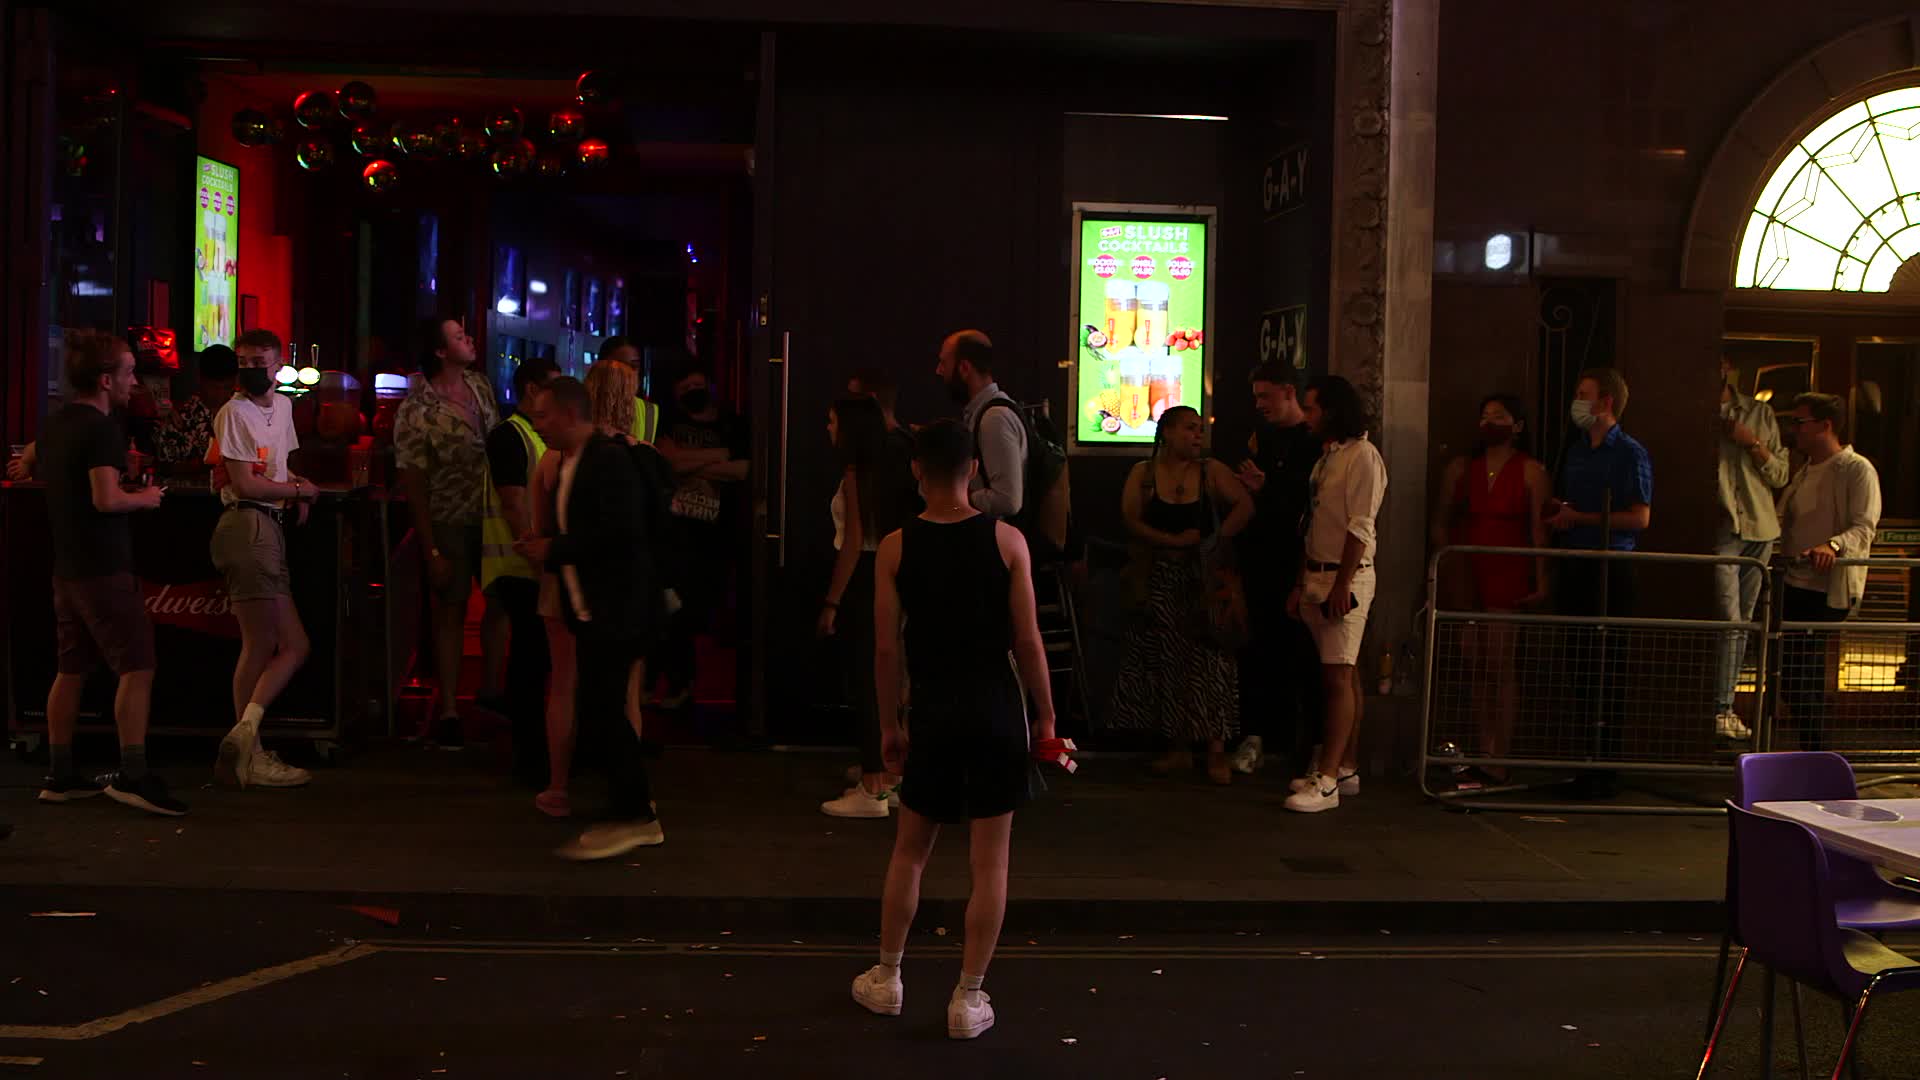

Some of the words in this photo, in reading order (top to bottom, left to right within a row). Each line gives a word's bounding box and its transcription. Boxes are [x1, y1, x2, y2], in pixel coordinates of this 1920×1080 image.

[1263, 151, 1307, 209] G-A-Y
[1098, 239, 1188, 253] COCKTAILS
[1125, 225, 1189, 240] SLUSH
[1259, 311, 1305, 364] G-A-Y
